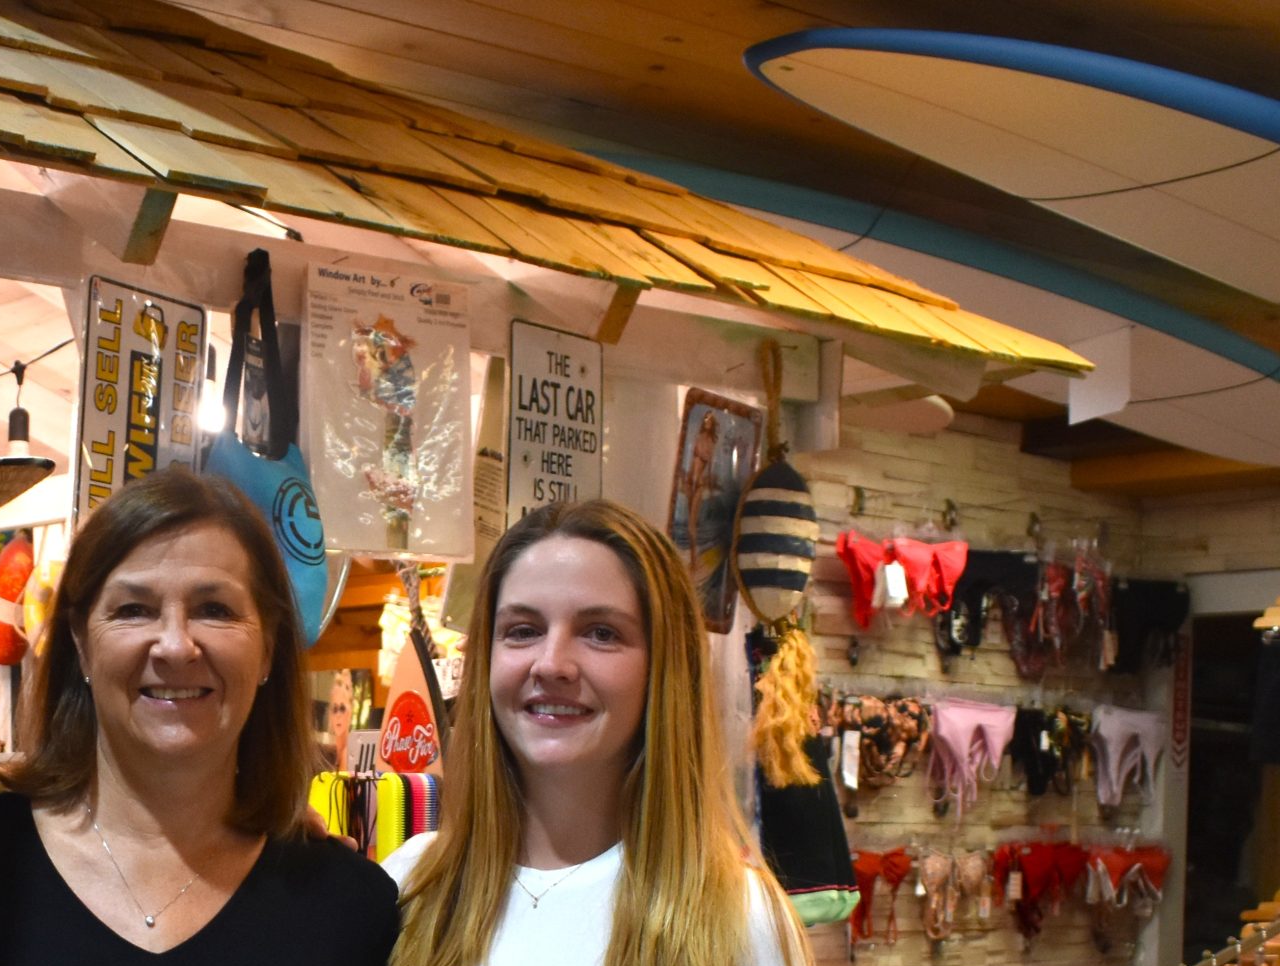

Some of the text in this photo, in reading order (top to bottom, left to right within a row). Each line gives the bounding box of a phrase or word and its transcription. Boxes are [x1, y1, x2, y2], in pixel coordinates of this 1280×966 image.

[317, 267, 352, 283] Window
[353, 272, 366, 284] Art
[94, 298, 123, 415] SELL
[546, 351, 570, 378] THE
[170, 319, 200, 446] BEER
[518, 375, 595, 425] LAST CAR
[515, 416, 597, 454] THAT PARKED
[541, 451, 573, 477] HERE
[533, 478, 577, 503] IS STILL
